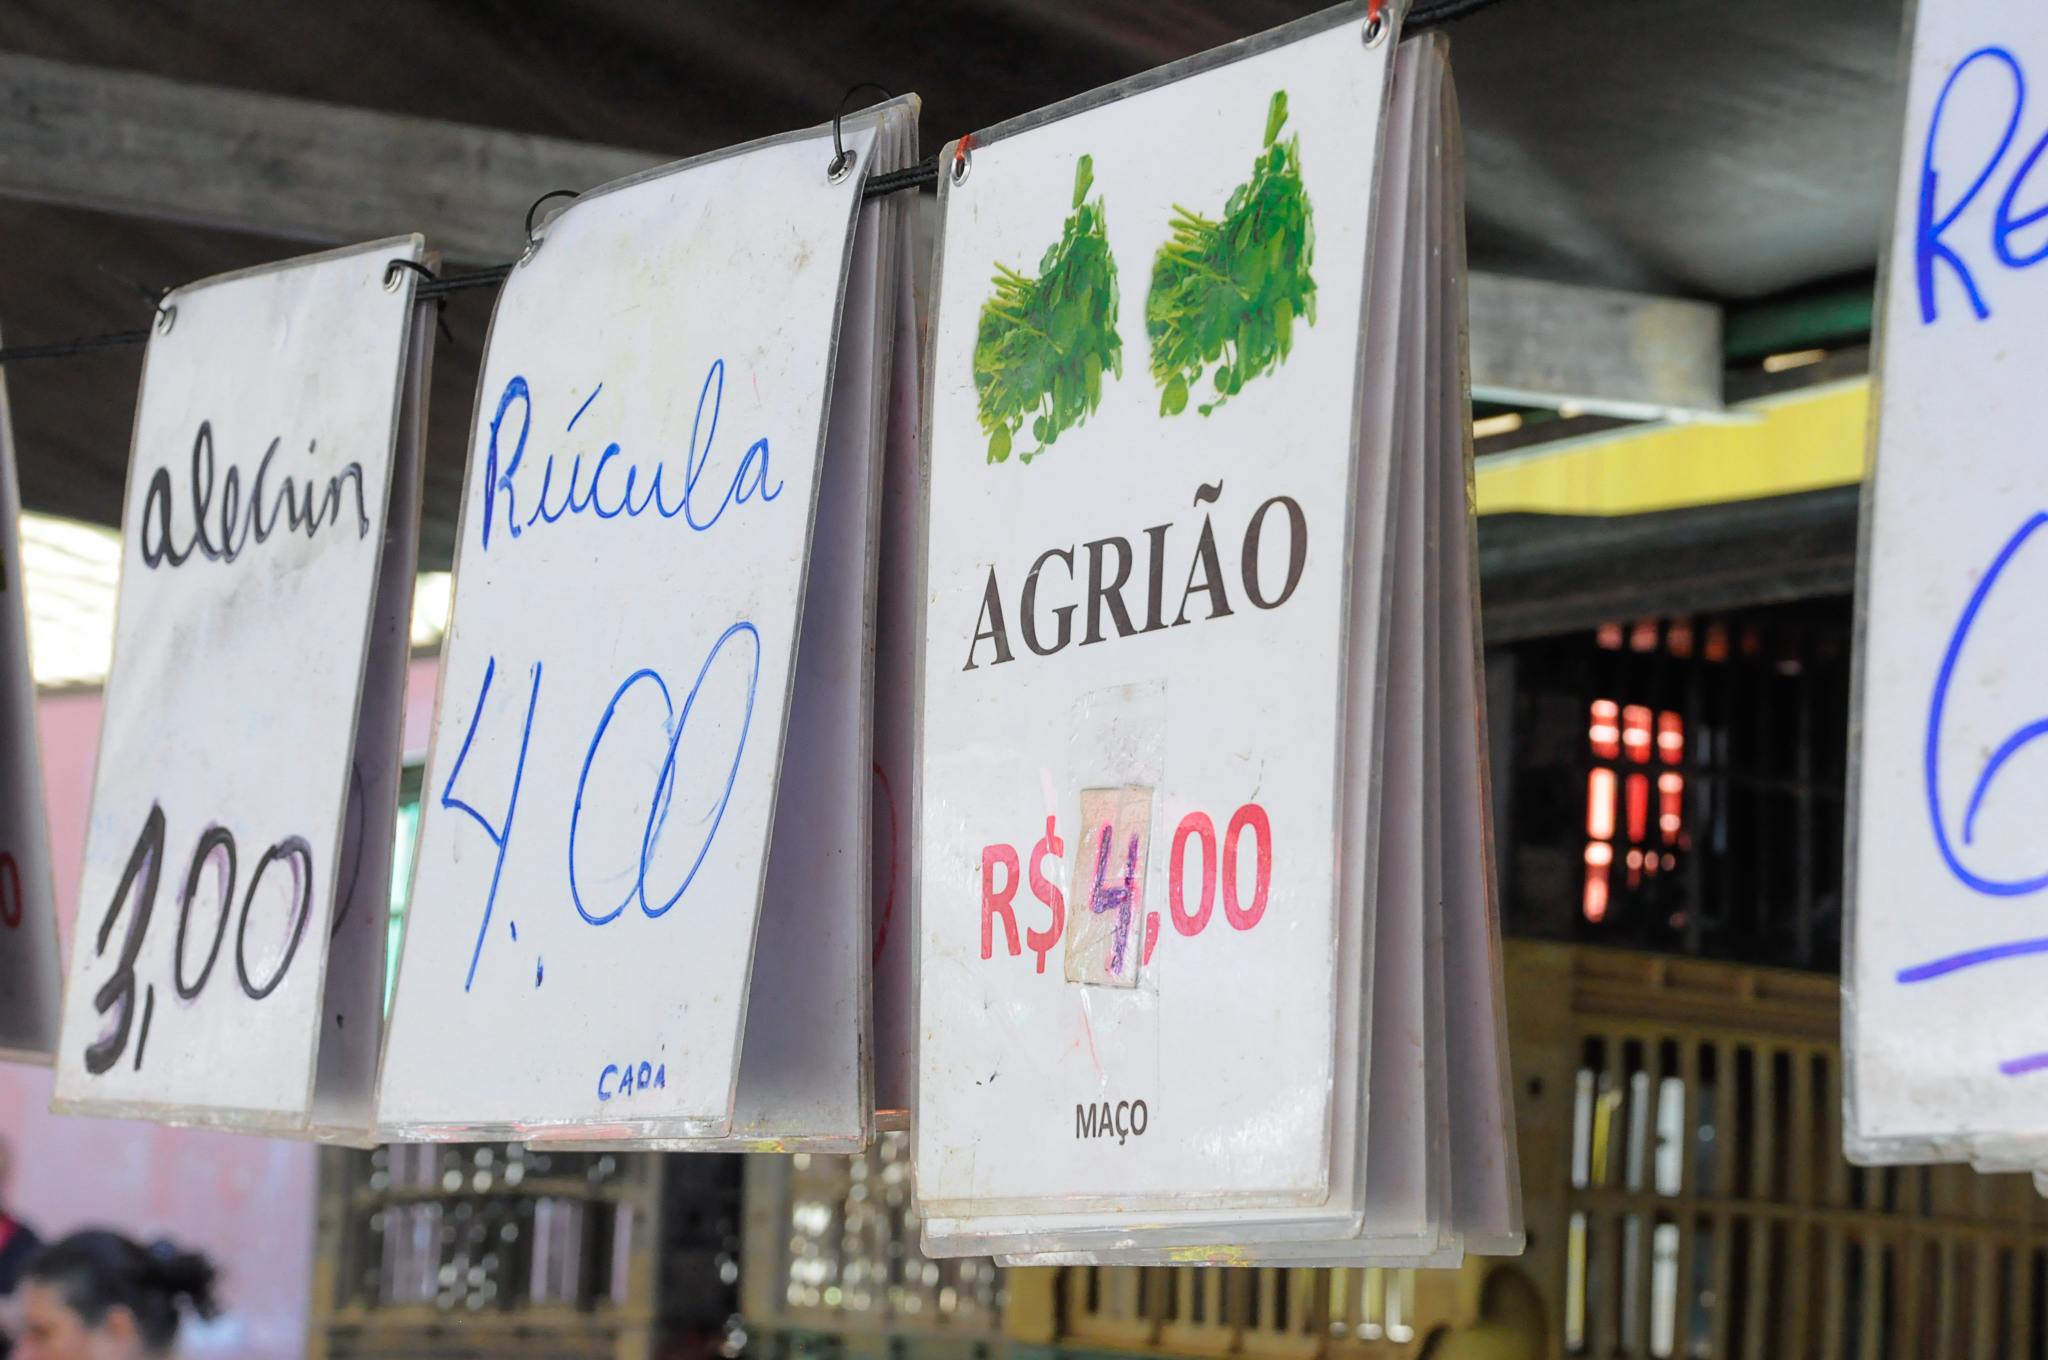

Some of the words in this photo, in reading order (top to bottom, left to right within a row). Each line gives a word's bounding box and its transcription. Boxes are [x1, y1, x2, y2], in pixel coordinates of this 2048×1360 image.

[482, 358, 783, 551] Rúcula
[962, 479, 1308, 672] AGRIÃO
[597, 1060, 665, 1101] CADA
[1076, 1099, 1148, 1146] MAÇO
